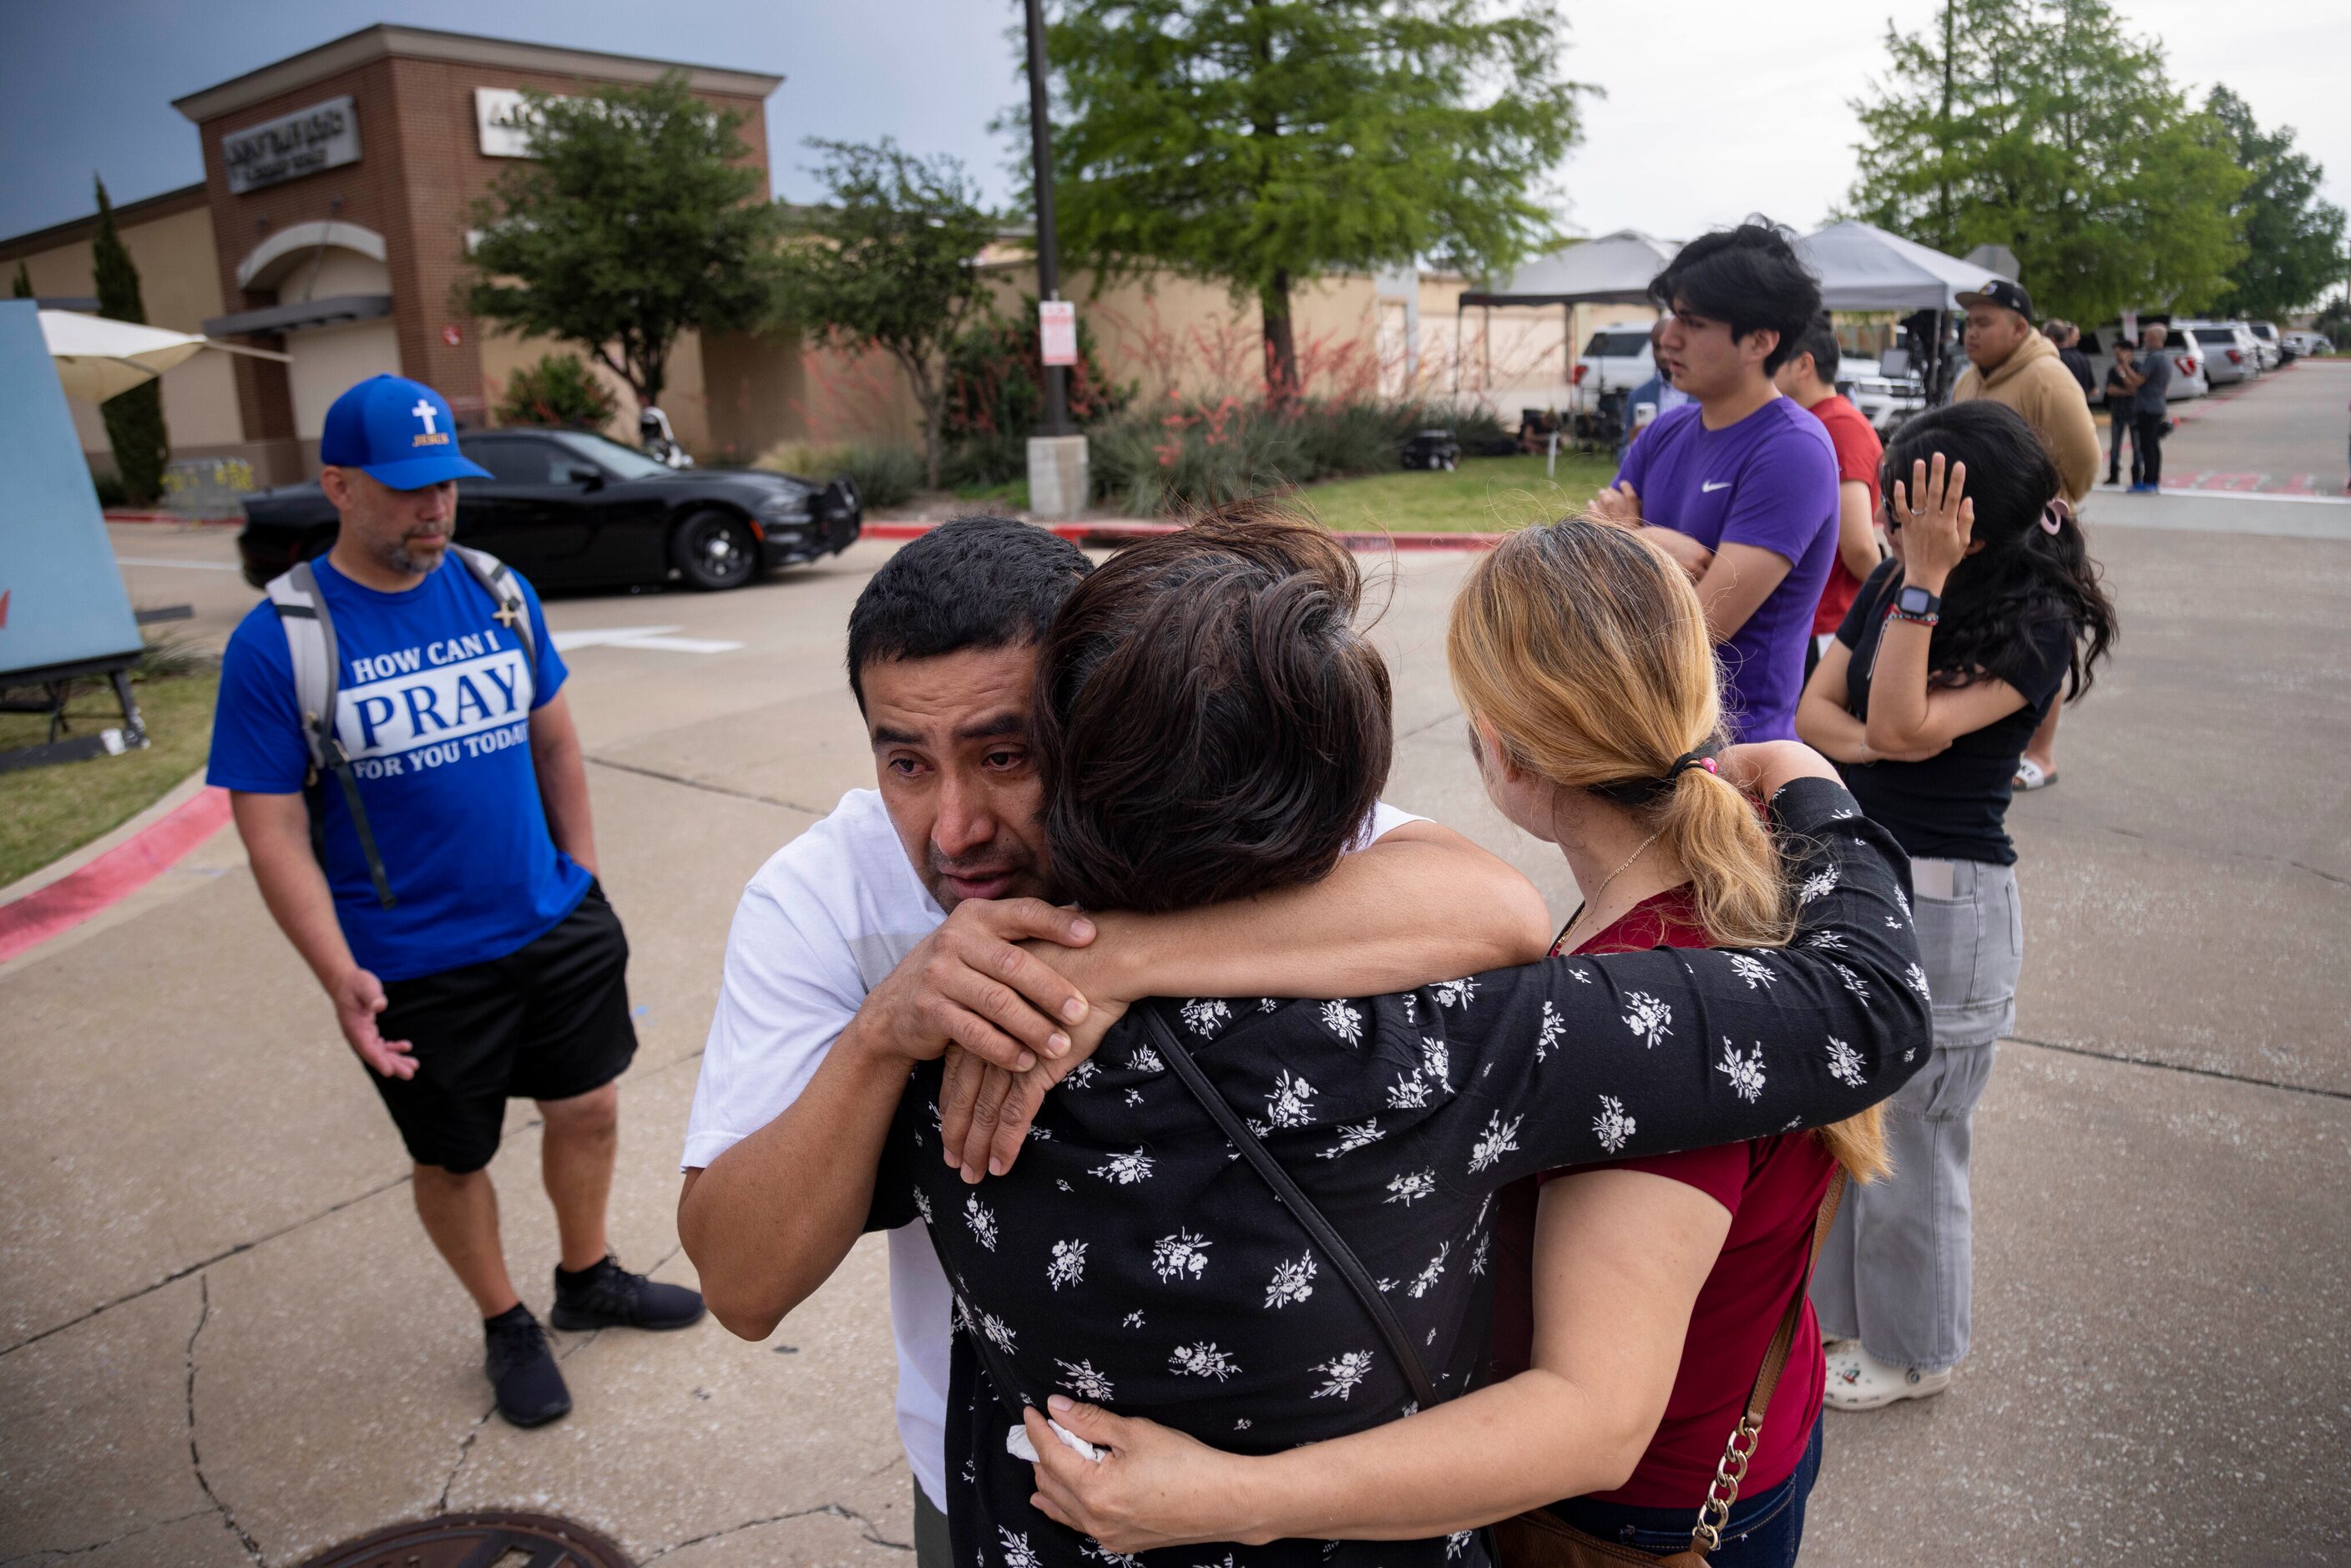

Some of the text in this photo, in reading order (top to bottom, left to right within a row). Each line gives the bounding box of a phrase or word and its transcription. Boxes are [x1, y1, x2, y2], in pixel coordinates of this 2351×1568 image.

[412, 432, 449, 448] JESUS
[351, 629, 501, 684] HOW CAN I
[353, 663, 522, 750] PRAY
[353, 756, 404, 780] FOR
[407, 741, 461, 771] YOU
